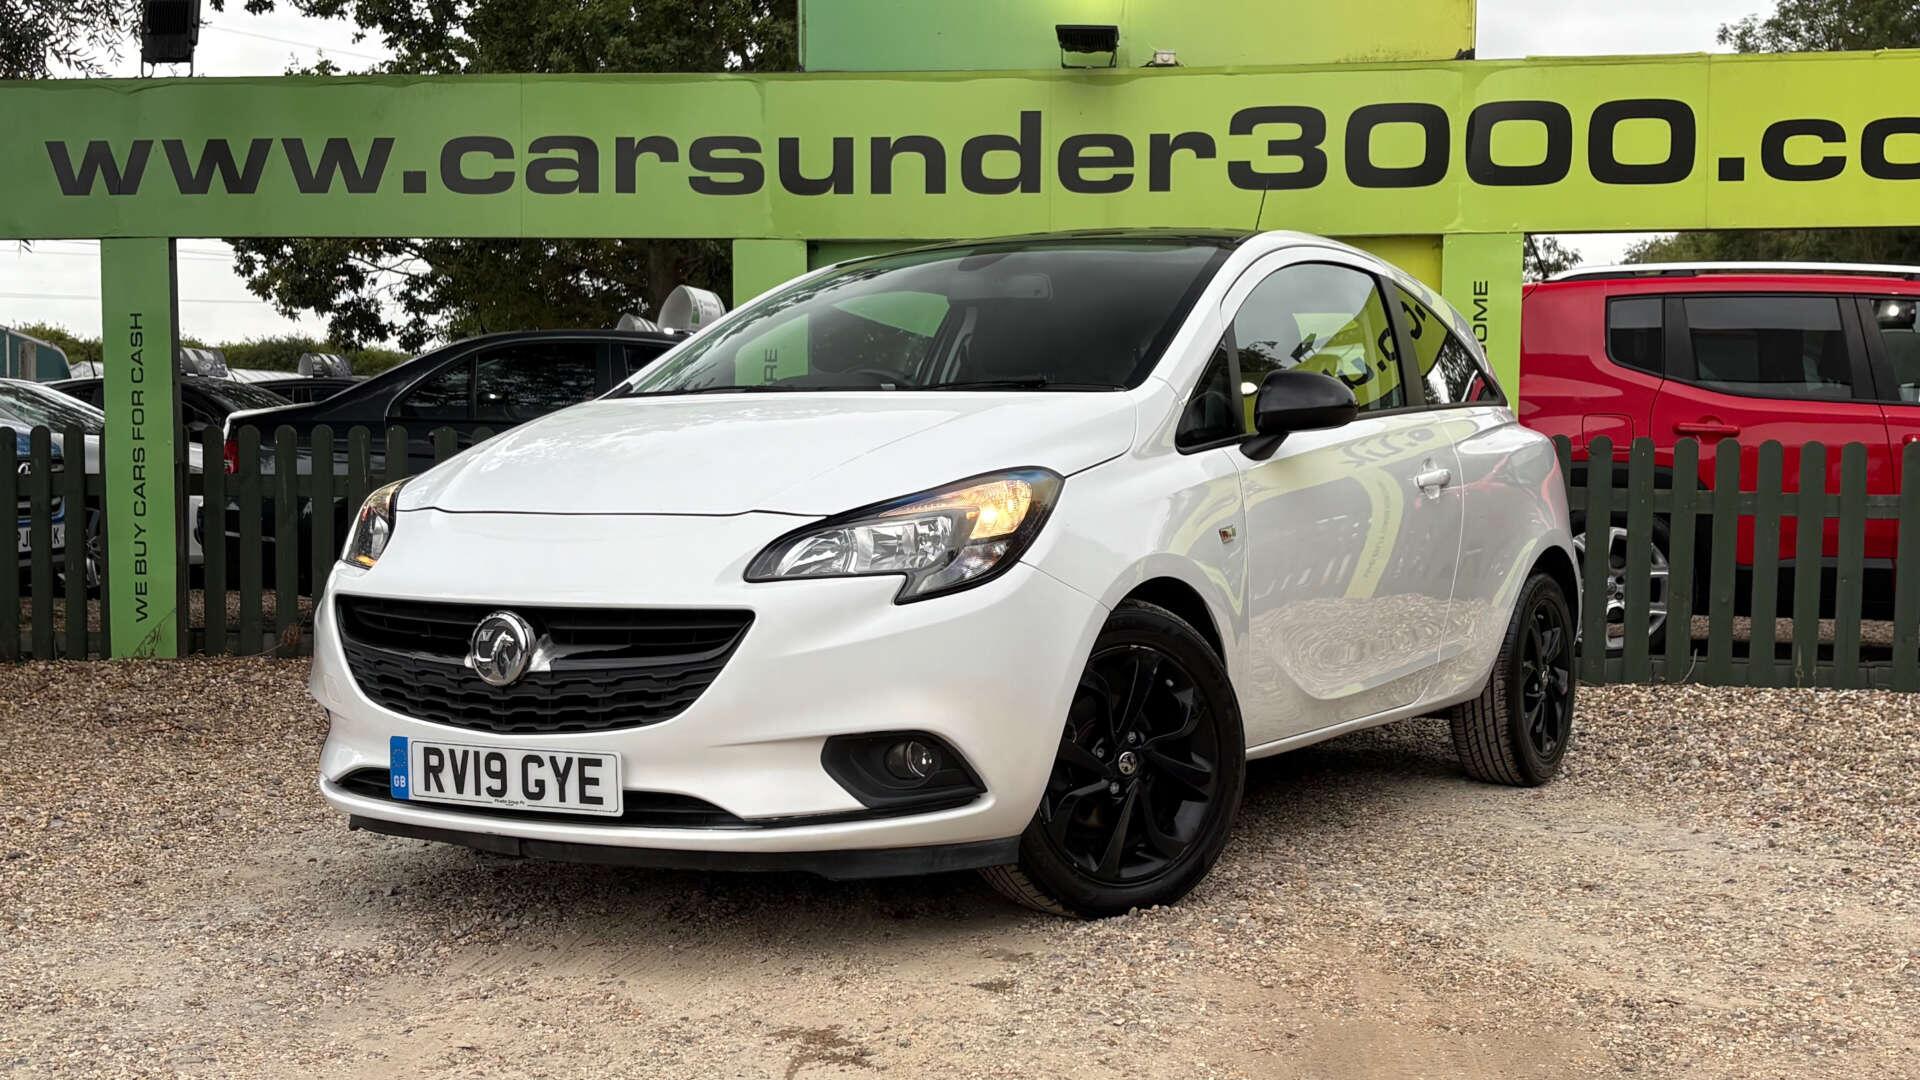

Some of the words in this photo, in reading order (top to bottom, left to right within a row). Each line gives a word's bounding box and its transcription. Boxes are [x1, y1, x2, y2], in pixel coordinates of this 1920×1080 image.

[1473, 280, 1489, 354] OME
[129, 312, 144, 383] CASH
[130, 389, 145, 440] FOR
[132, 447, 147, 516] CARS
[133, 522, 148, 576] BUY
[134, 580, 149, 623] WE
[393, 775, 406, 788] GB
[423, 746, 508, 798] RV19
[521, 753, 604, 806] GYE
